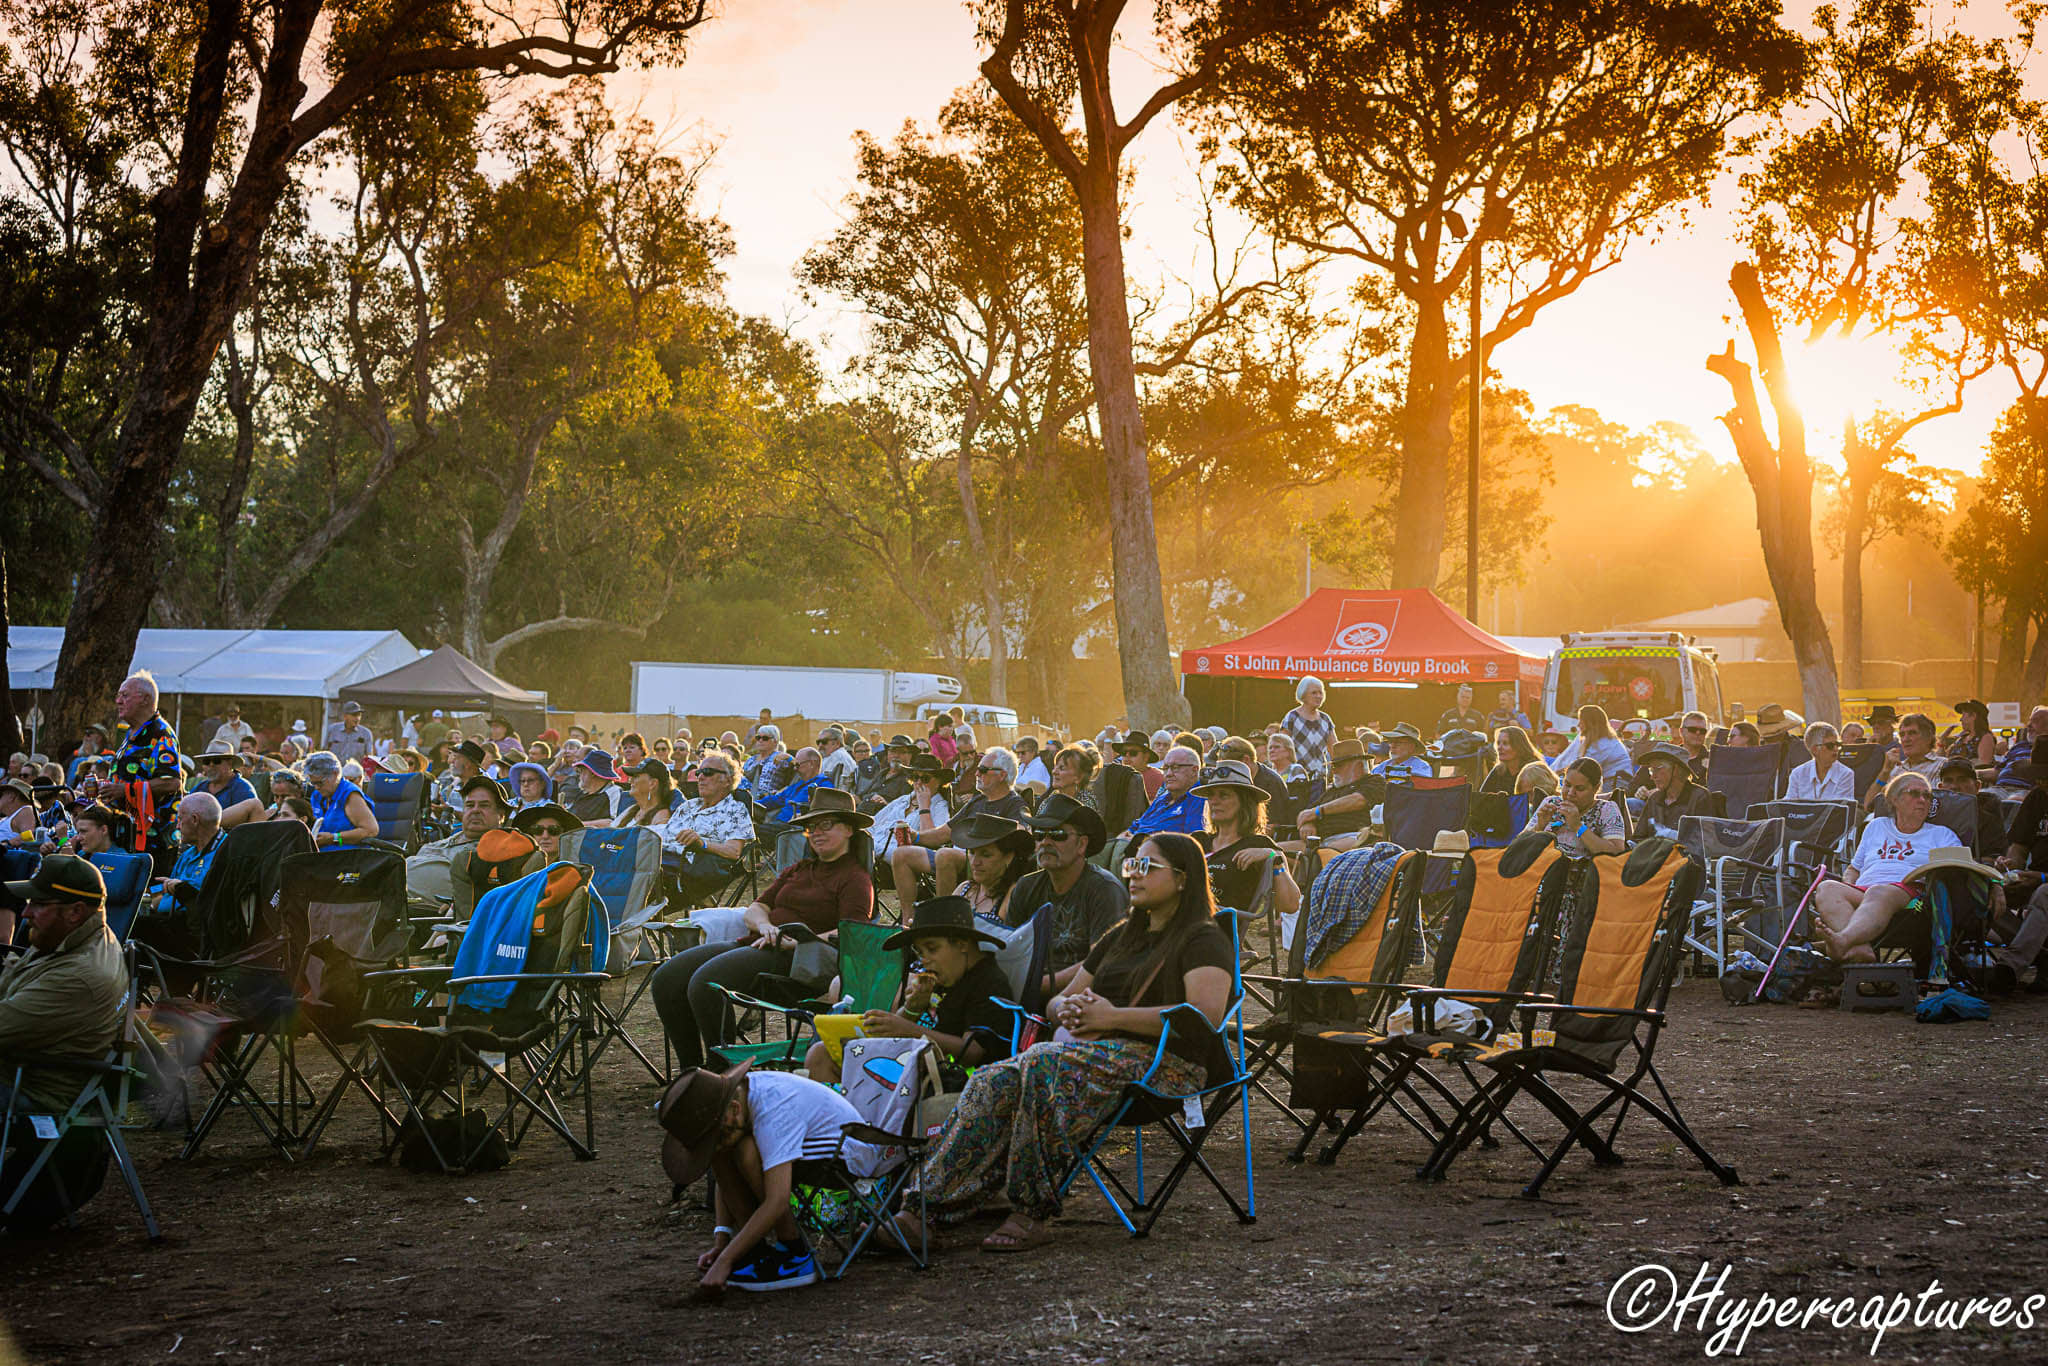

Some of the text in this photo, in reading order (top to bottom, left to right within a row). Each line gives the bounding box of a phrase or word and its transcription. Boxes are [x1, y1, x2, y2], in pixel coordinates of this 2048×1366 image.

[1223, 654, 1471, 676] St John Ambulance Boyup Brook
